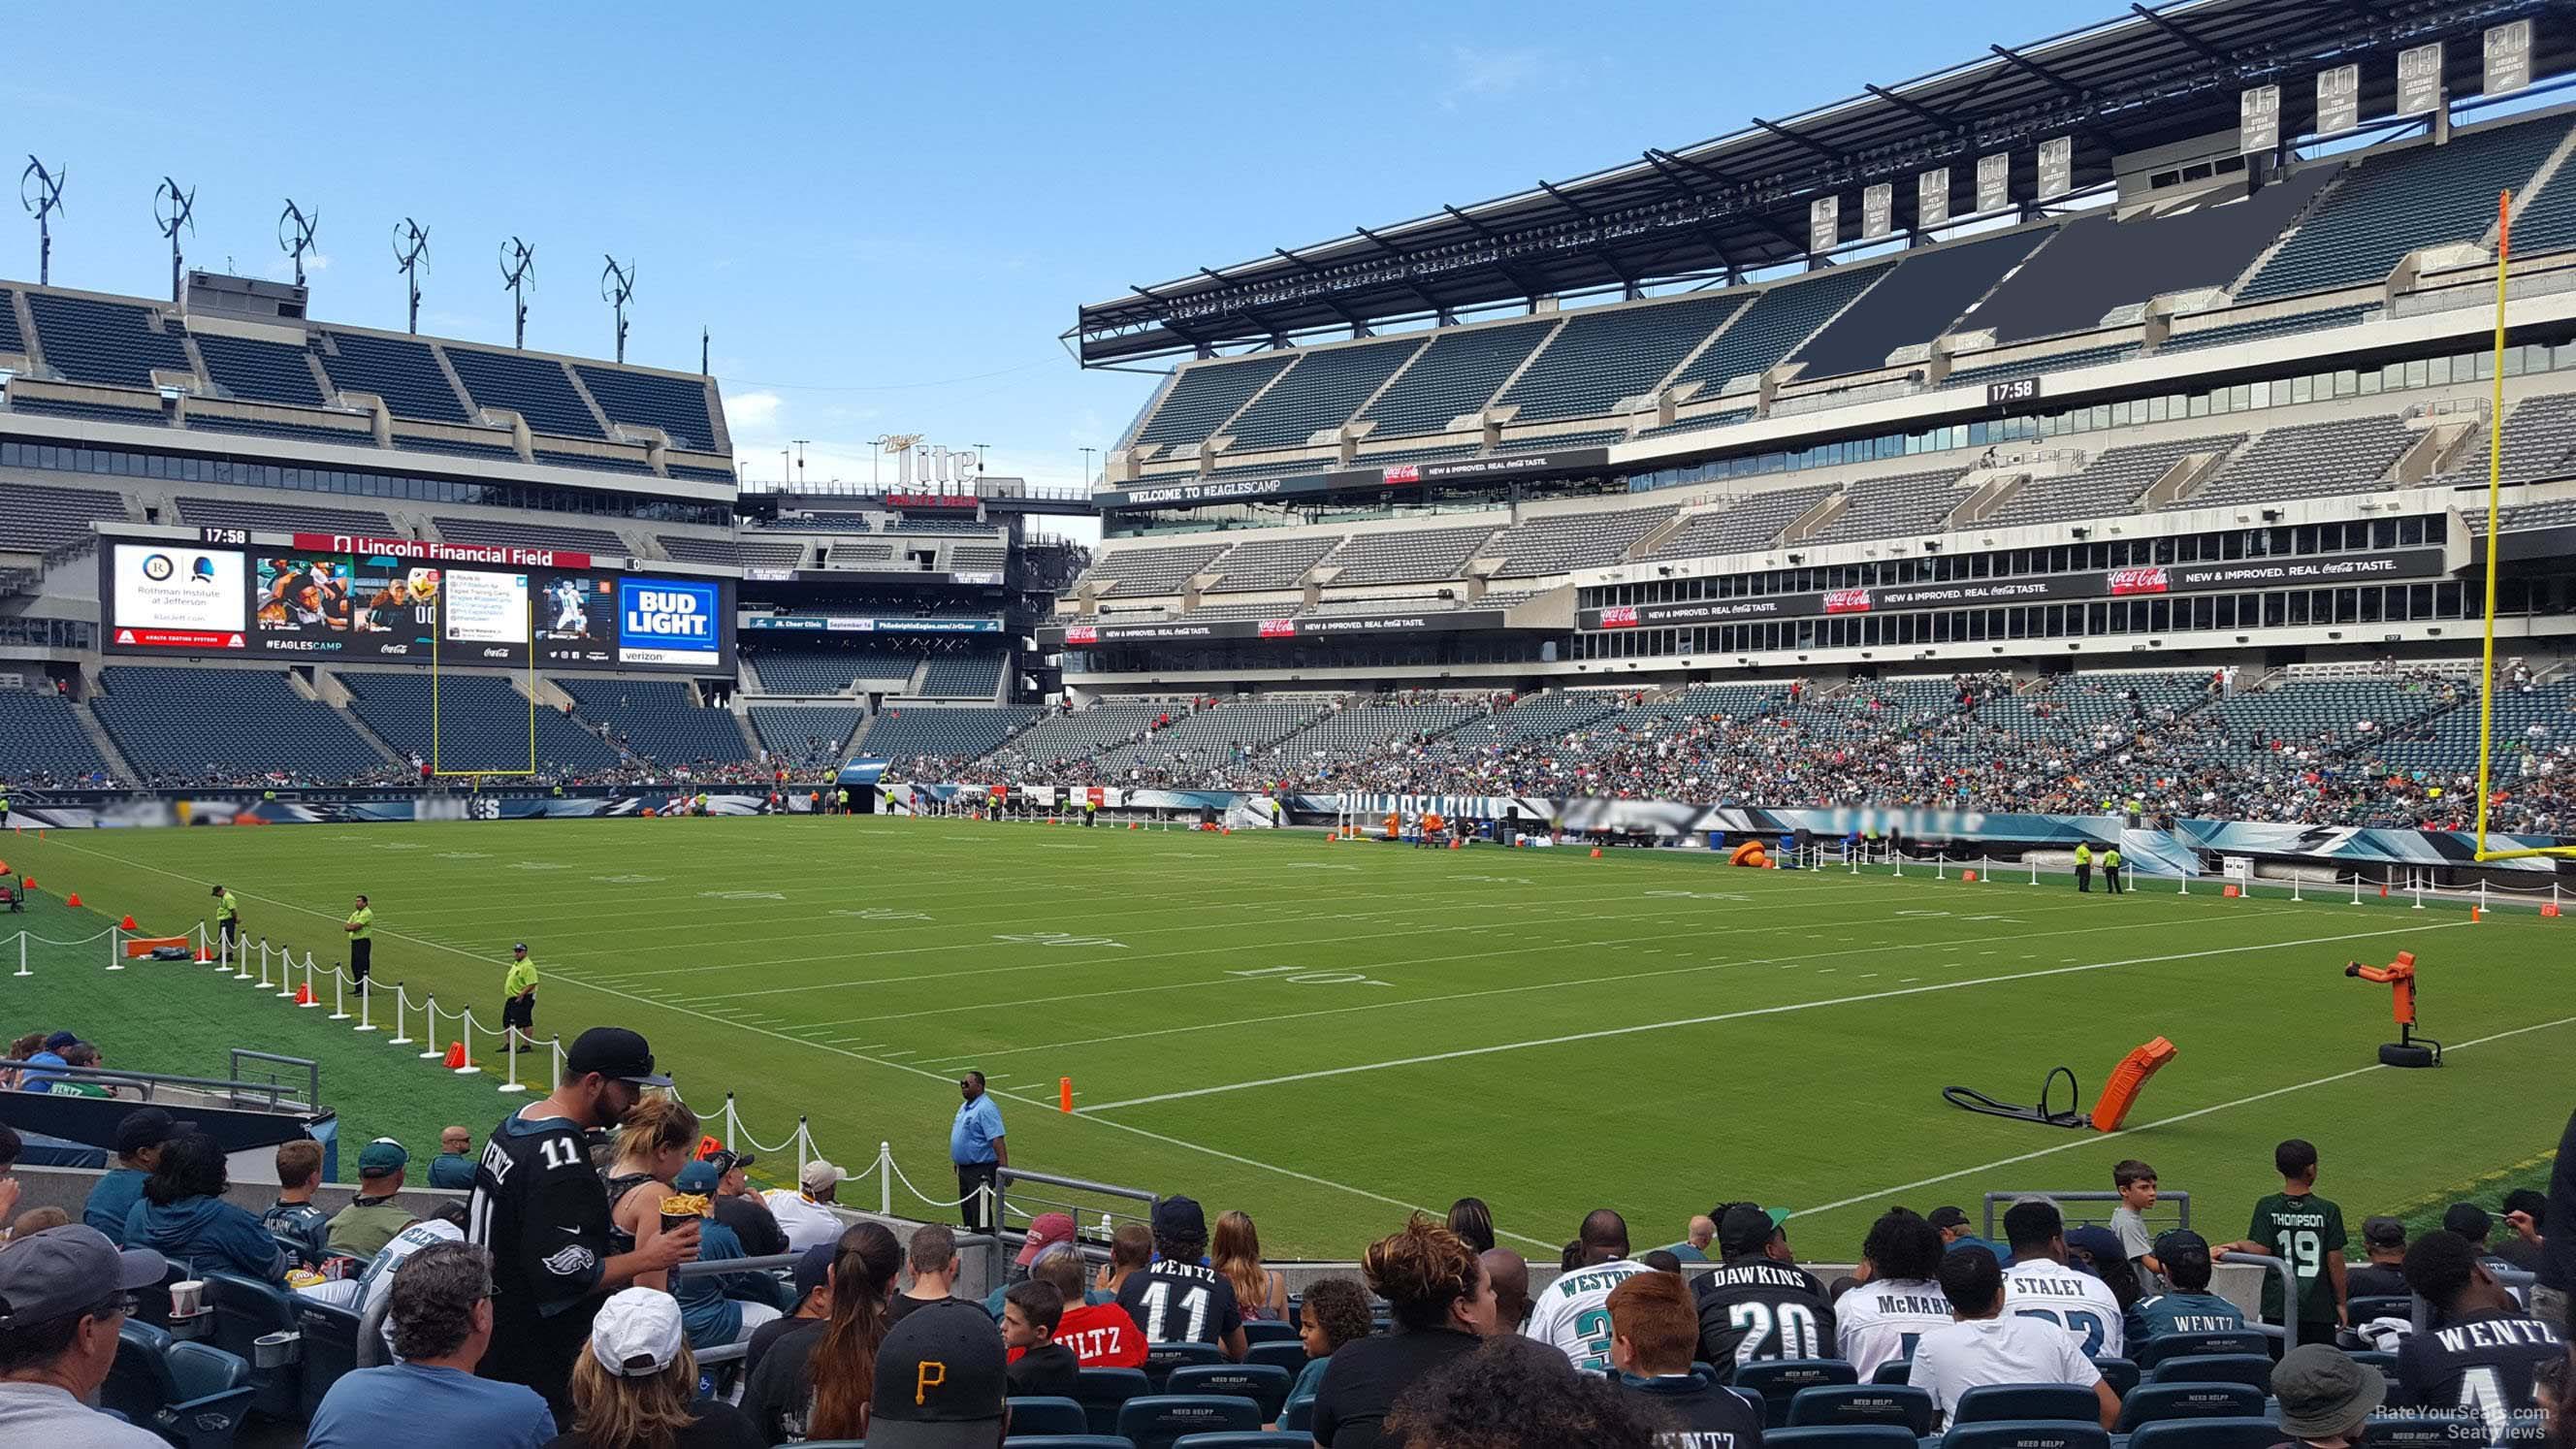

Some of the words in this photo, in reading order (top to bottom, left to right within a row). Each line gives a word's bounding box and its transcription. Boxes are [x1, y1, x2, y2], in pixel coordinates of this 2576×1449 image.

[2488, 23, 2528, 55] 20
[2401, 47, 2438, 79] 99
[2490, 62, 2524, 76] DAWKINS
[2321, 66, 2354, 95] 40
[2405, 85, 2432, 96] BROWN
[2244, 86, 2275, 114] 15
[2041, 139, 2068, 167] 70
[1980, 155, 2006, 182] 60
[1921, 170, 1947, 195] 44
[1819, 199, 1831, 221] 5
[1993, 380, 2033, 401] 17:58
[878, 434, 925, 454] Miller
[894, 445, 977, 493] Lite
[1128, 489, 1181, 503] WELCOME
[1185, 487, 1200, 499] TO
[1204, 480, 1280, 498] #EAGLESCAMP
[206, 529, 245, 543] 17:58
[358, 536, 423, 558] Lincoln
[430, 544, 506, 564] Financial
[512, 549, 553, 566] Field
[153, 562, 164, 572] R
[633, 559, 640, 569] 0
[2185, 572, 2212, 583] NEW
[2225, 567, 2285, 580] IMPROVED.
[2289, 564, 2321, 577] REAL
[2355, 560, 2397, 572] TASTE.
[138, 587, 180, 596] Rothman
[182, 589, 220, 598] Institute
[164, 597, 207, 606] Jefferson
[639, 591, 696, 613] BUD
[1884, 595, 1906, 603] NEW
[1916, 591, 1962, 601] IMPROVED.
[1965, 588, 1989, 597] REAL
[2016, 584, 2048, 595] TASTE.
[828, 622, 863, 630] September
[1649, 611, 1665, 620] NEW
[267, 640, 342, 651] #EAGLESCAMP
[626, 651, 663, 660] verizon
[991, 931, 1113, 948] 20
[1223, 966, 1367, 984] 10
[539, 1137, 582, 1171] 11
[2270, 1213, 2325, 1228] THOMPSON
[2276, 1230, 2321, 1277] 19
[1150, 1260, 1215, 1283] WENTZ
[1713, 1266, 1807, 1289] DAWKINS
[2014, 1276, 2086, 1297] STALEY
[1139, 1279, 1211, 1343] 11
[1728, 1301, 1819, 1361] 20
[2014, 1309, 2105, 1359] 2
[2174, 1315, 2234, 1332] WENTZ
[2435, 1319, 2560, 1353] WENTZ
[916, 1361, 946, 1405] P
